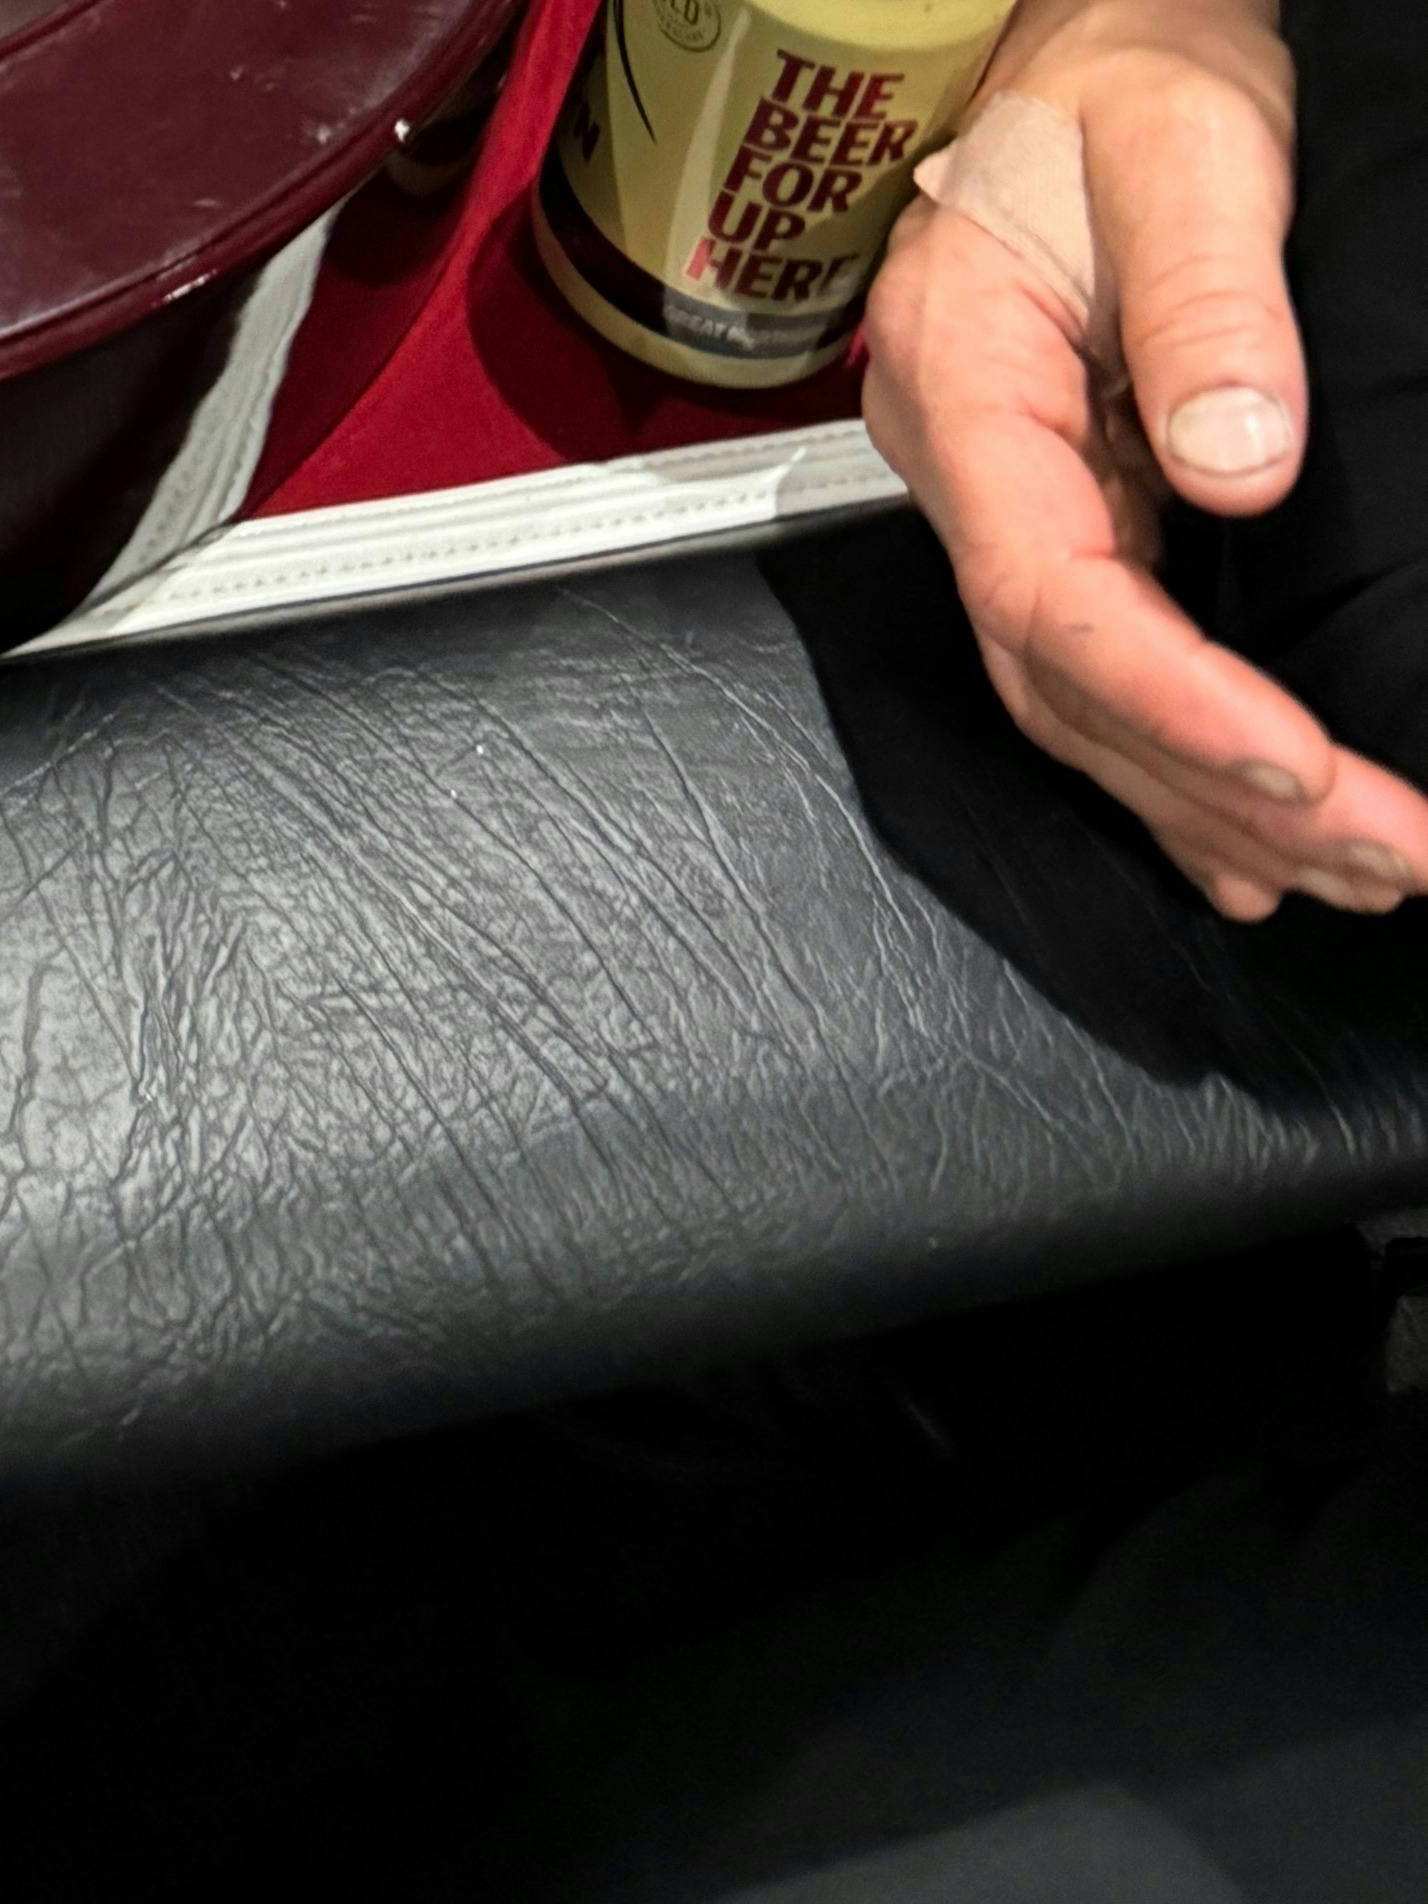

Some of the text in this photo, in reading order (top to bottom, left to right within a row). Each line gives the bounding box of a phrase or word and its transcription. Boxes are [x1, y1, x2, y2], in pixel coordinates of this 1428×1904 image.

[775, 48, 904, 121] THE
[743, 98, 919, 170] BEER
[722, 143, 862, 214] FOR
[708, 190, 806, 252] UP
